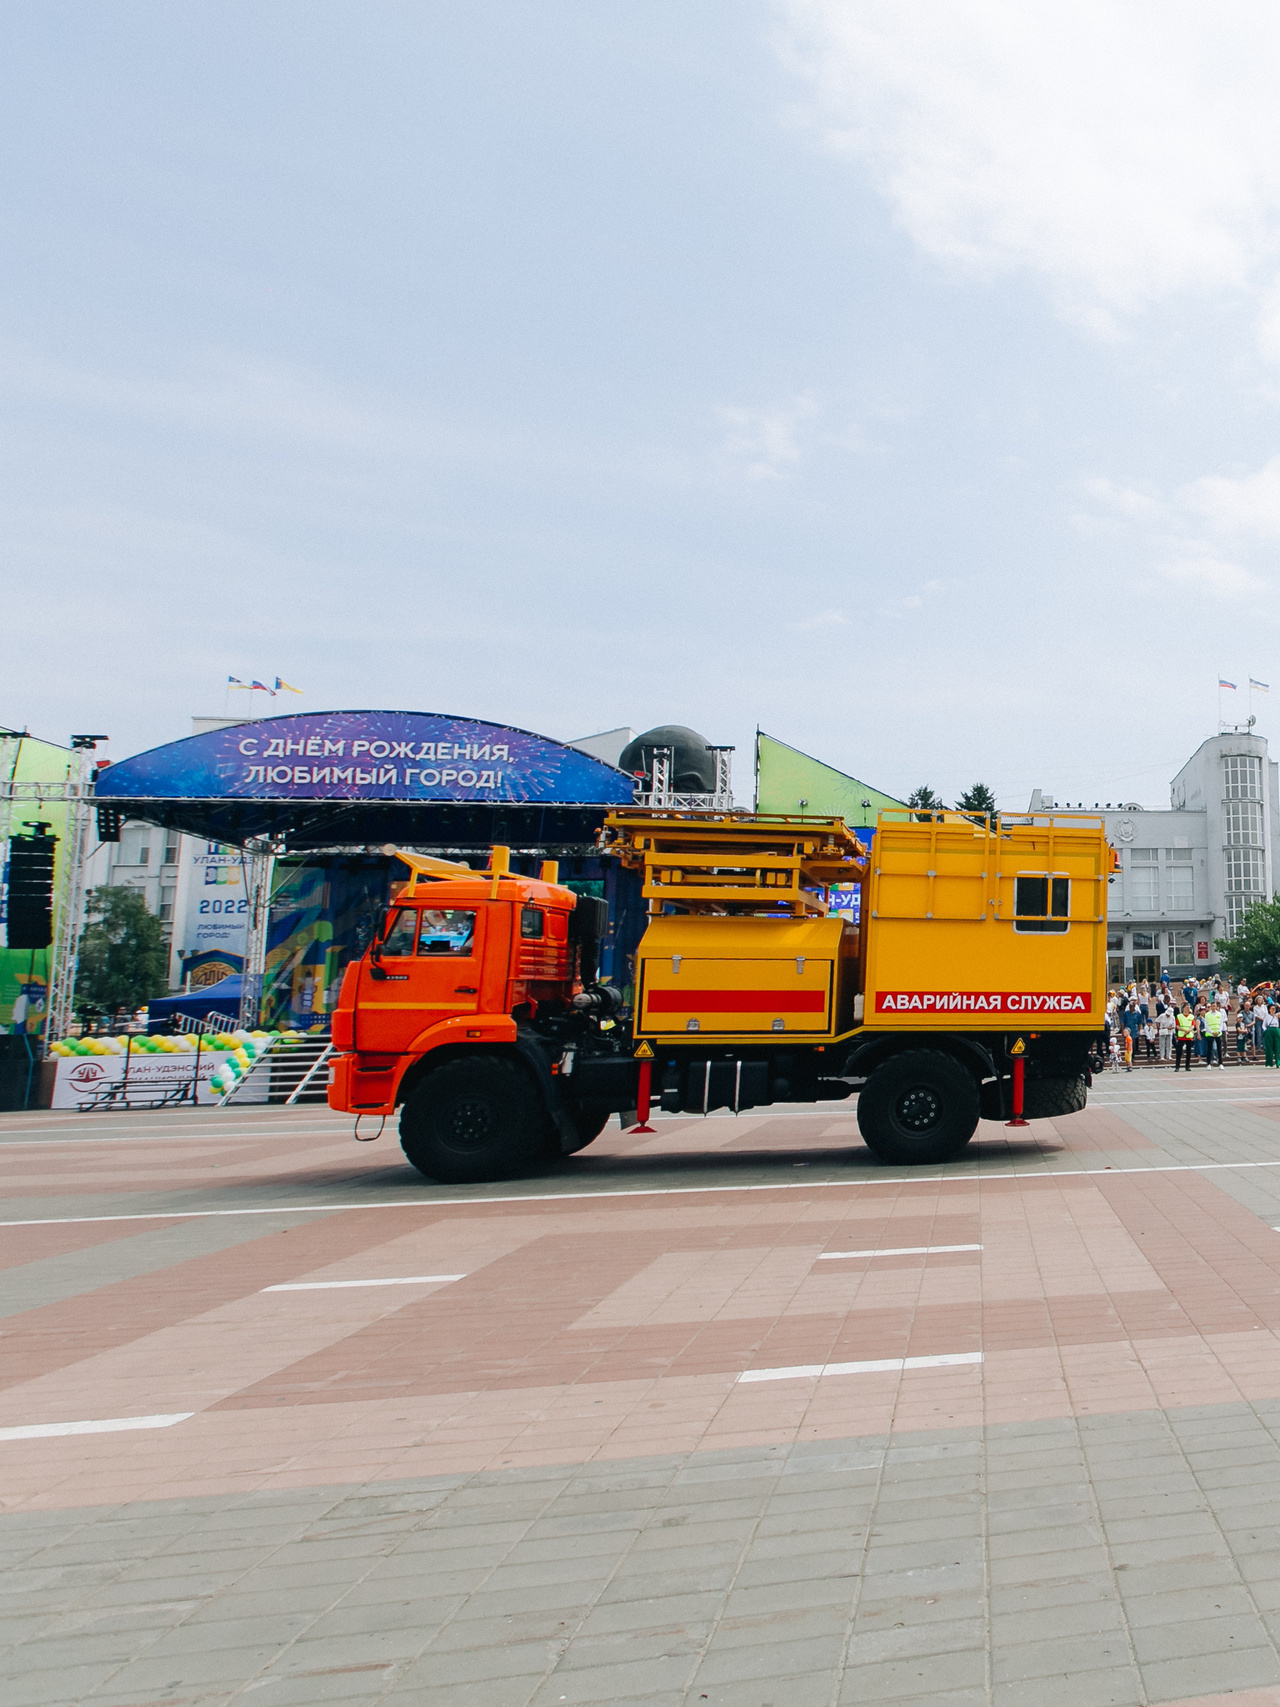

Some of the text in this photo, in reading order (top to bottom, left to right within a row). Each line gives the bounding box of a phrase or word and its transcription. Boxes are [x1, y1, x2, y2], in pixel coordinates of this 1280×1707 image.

[239, 736, 515, 763] С ДНЁМ РОЖДЕНИЯ,
[244, 764, 502, 788] ЛЮБИМЫЙ ГОРОД!
[199, 899, 248, 914] 2022
[881, 992, 1086, 1010] АВАРИЙНАЯ СЛУЖБА
